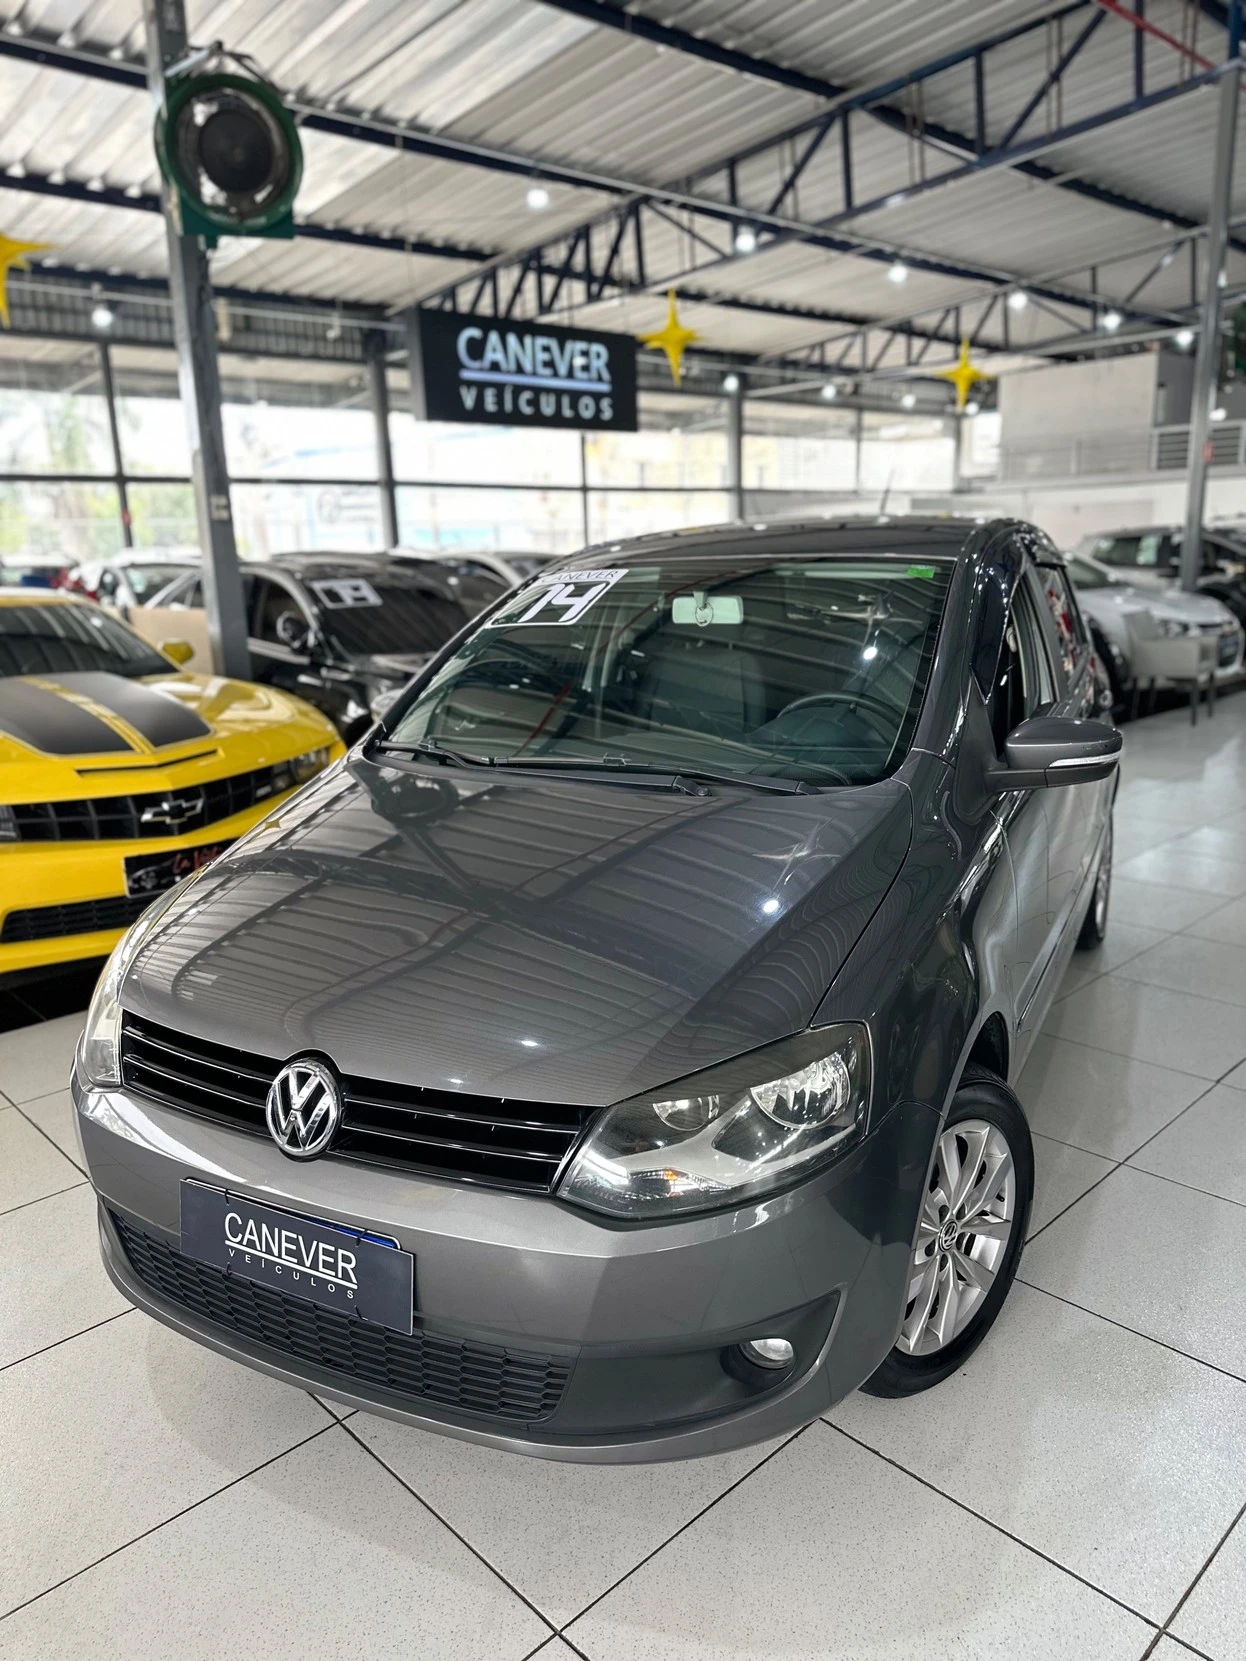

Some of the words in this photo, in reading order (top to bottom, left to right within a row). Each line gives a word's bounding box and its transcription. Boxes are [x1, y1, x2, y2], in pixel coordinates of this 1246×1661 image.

[456, 326, 612, 382] CANEVER
[459, 384, 614, 421] VEÍCULOS
[517, 583, 607, 623] 14
[224, 1212, 358, 1284] CANEVER
